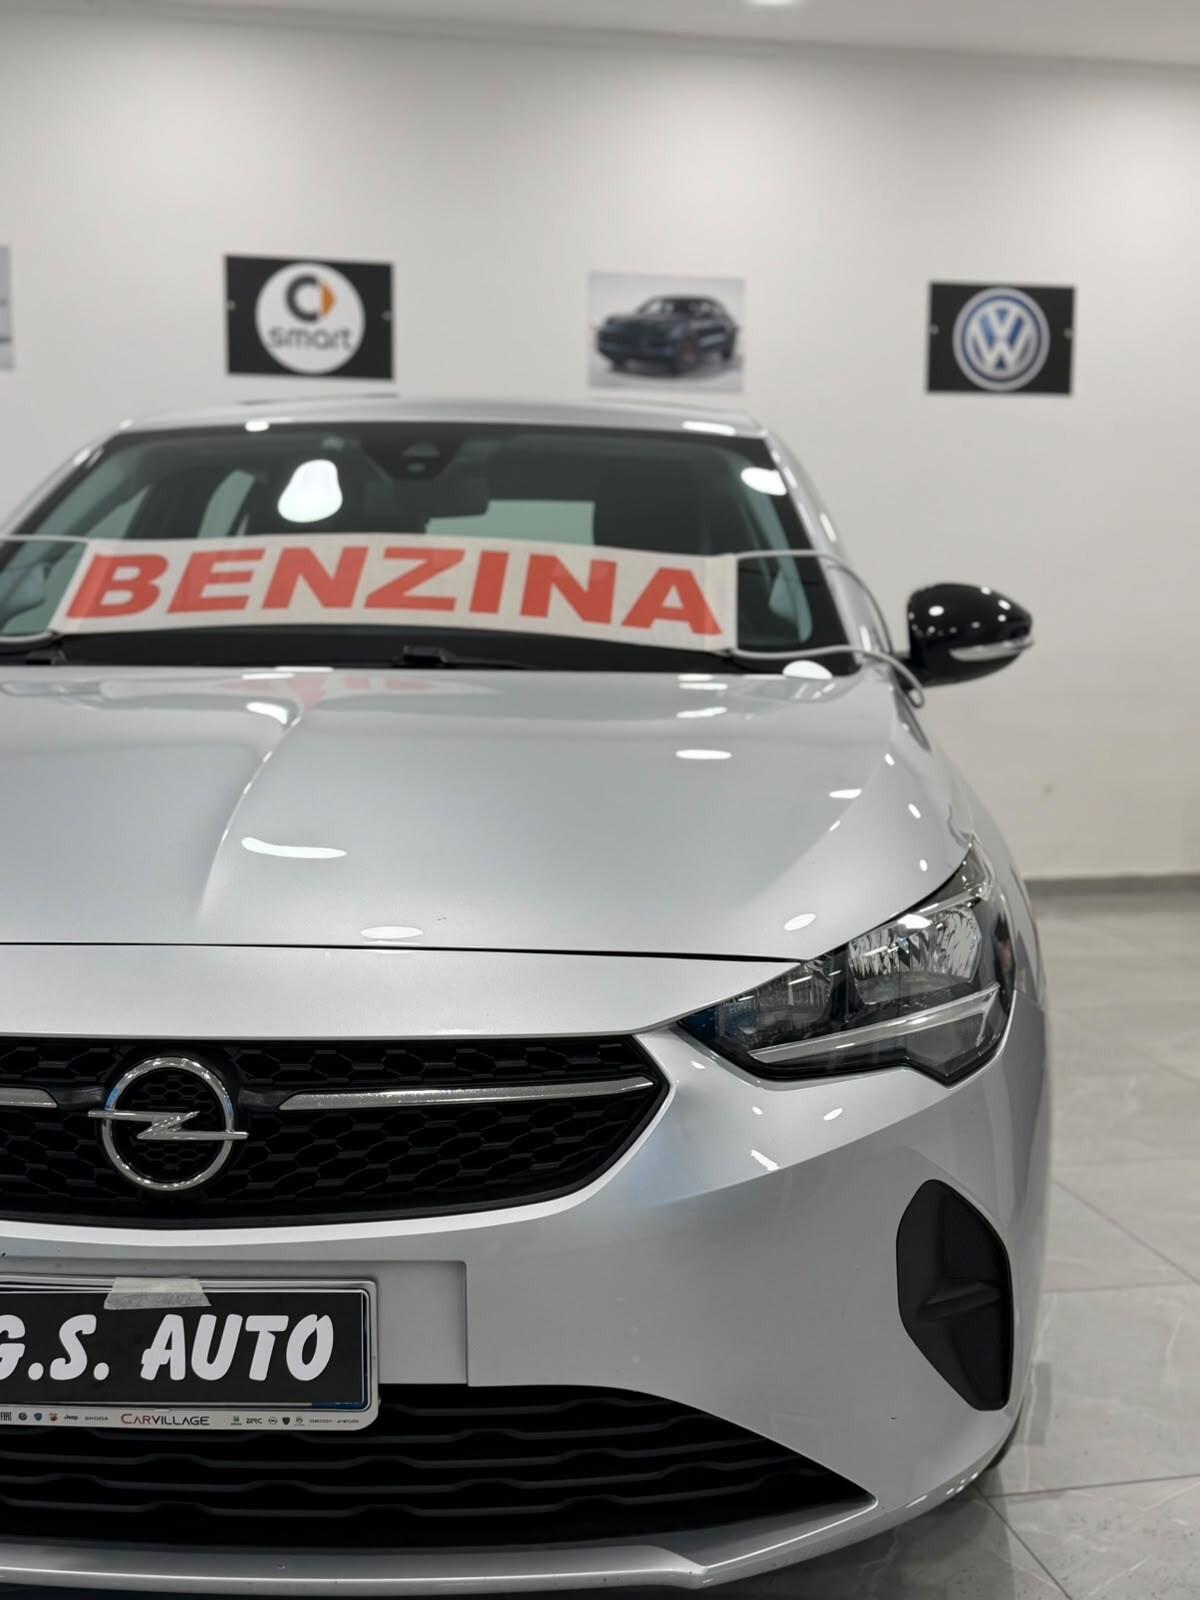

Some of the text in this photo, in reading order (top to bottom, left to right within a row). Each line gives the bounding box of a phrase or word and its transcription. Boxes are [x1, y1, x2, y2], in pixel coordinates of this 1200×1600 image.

[268, 326, 352, 351] smart
[66, 546, 722, 635] BENZINA
[140, 1314, 334, 1381] AUTO
[121, 1413, 210, 1425] CARVILLAGE
